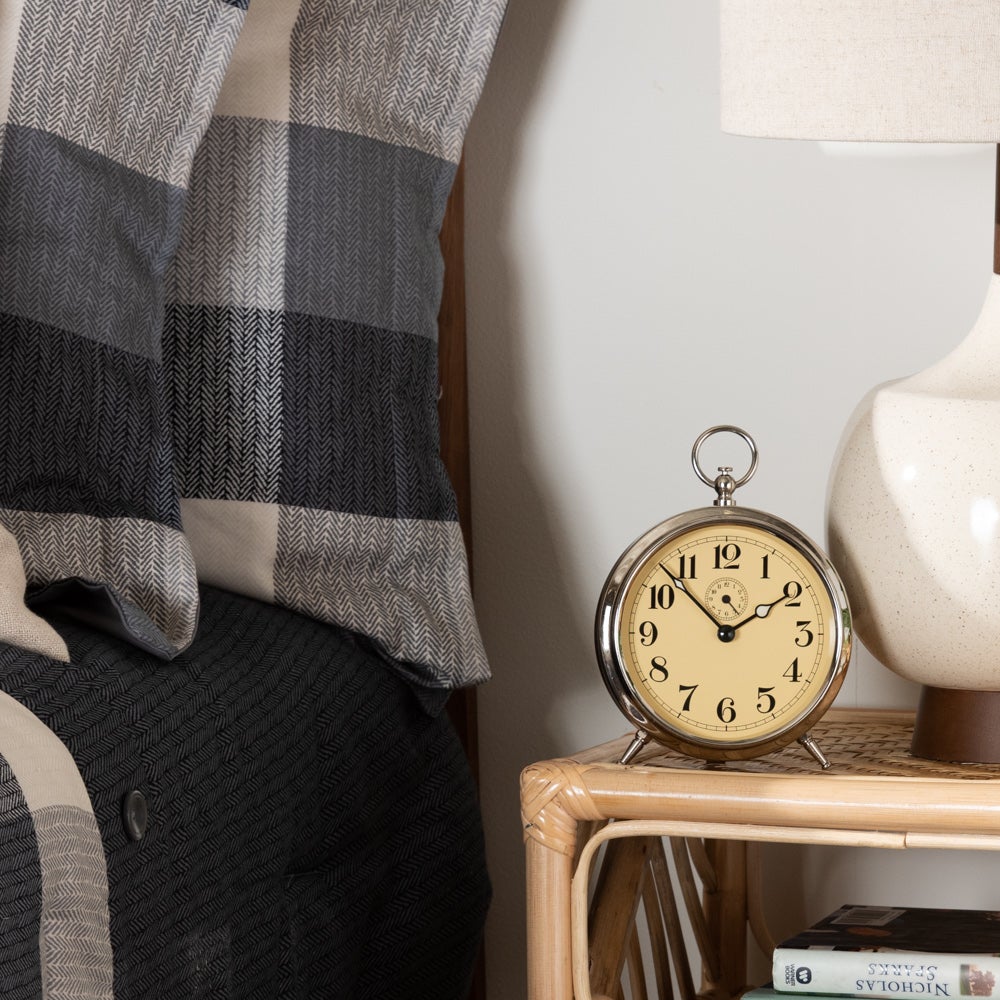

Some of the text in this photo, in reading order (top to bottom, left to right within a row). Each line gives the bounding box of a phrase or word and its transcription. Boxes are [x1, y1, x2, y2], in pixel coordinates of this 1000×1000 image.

[678, 554, 698, 579] 11
[712, 543, 742, 569] 12
[760, 554, 770, 579] 1
[648, 584, 675, 609] 10
[783, 581, 802, 607] 2
[639, 621, 658, 646] 9
[794, 620, 814, 647] 3
[649, 656, 669, 682] 8
[782, 657, 802, 682] 4
[678, 684, 699, 711] 7
[716, 697, 736, 723] 6
[756, 686, 776, 714] 5
[868, 962, 938, 981] SPARKS
[855, 979, 951, 996] NICHOLAS
